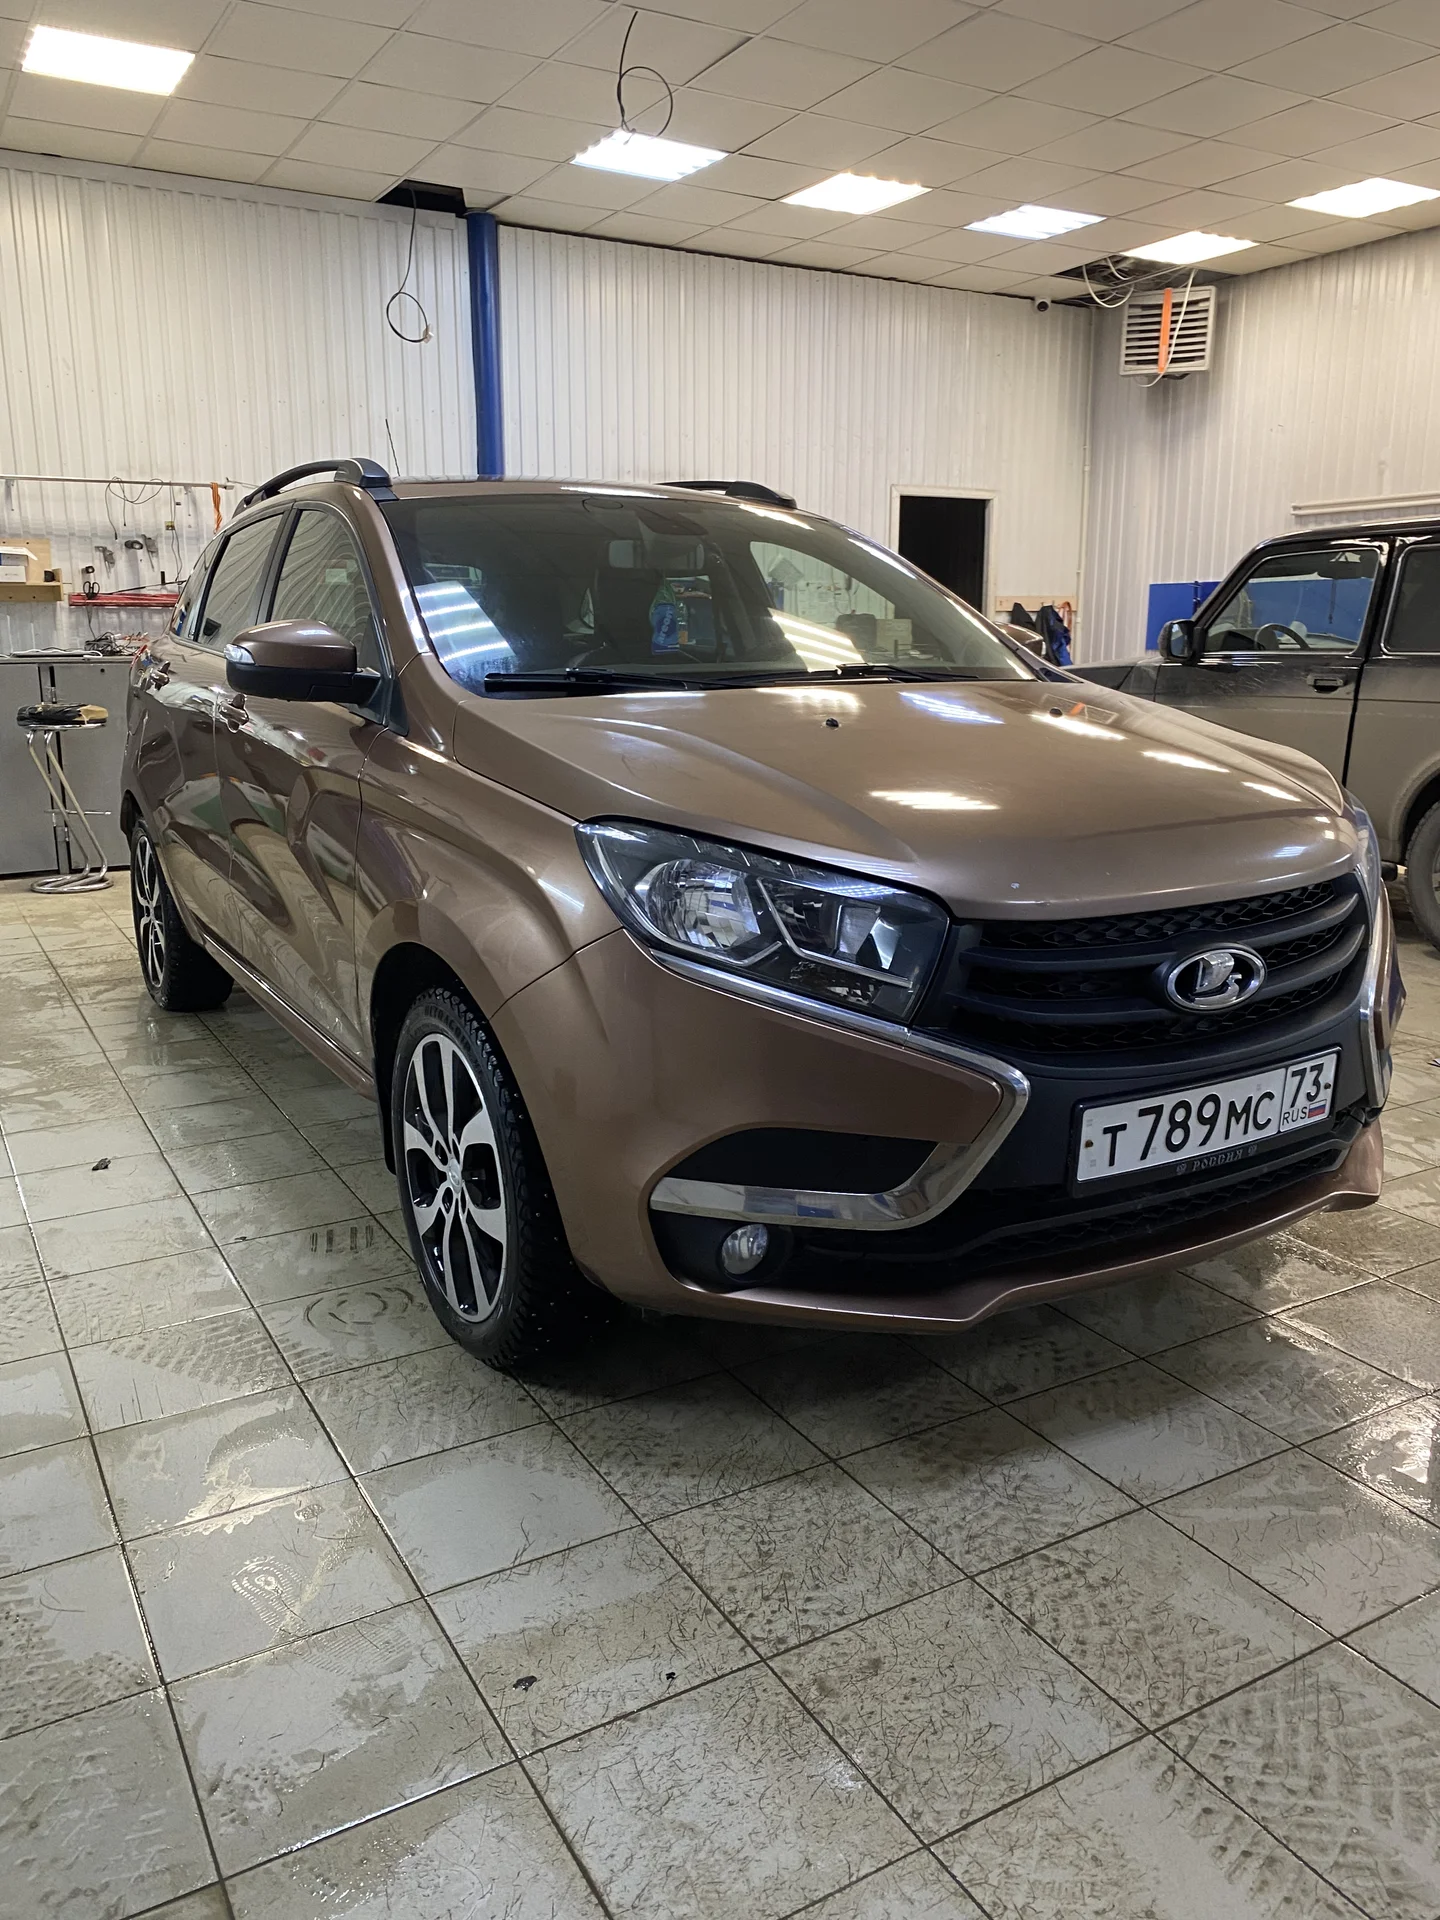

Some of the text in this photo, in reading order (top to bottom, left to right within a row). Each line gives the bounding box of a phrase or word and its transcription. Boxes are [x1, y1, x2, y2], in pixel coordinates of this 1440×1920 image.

[1289, 1062, 1324, 1109] 73
[1282, 1105, 1308, 1127] RUS
[1191, 1148, 1244, 1172] РОССИЯ
